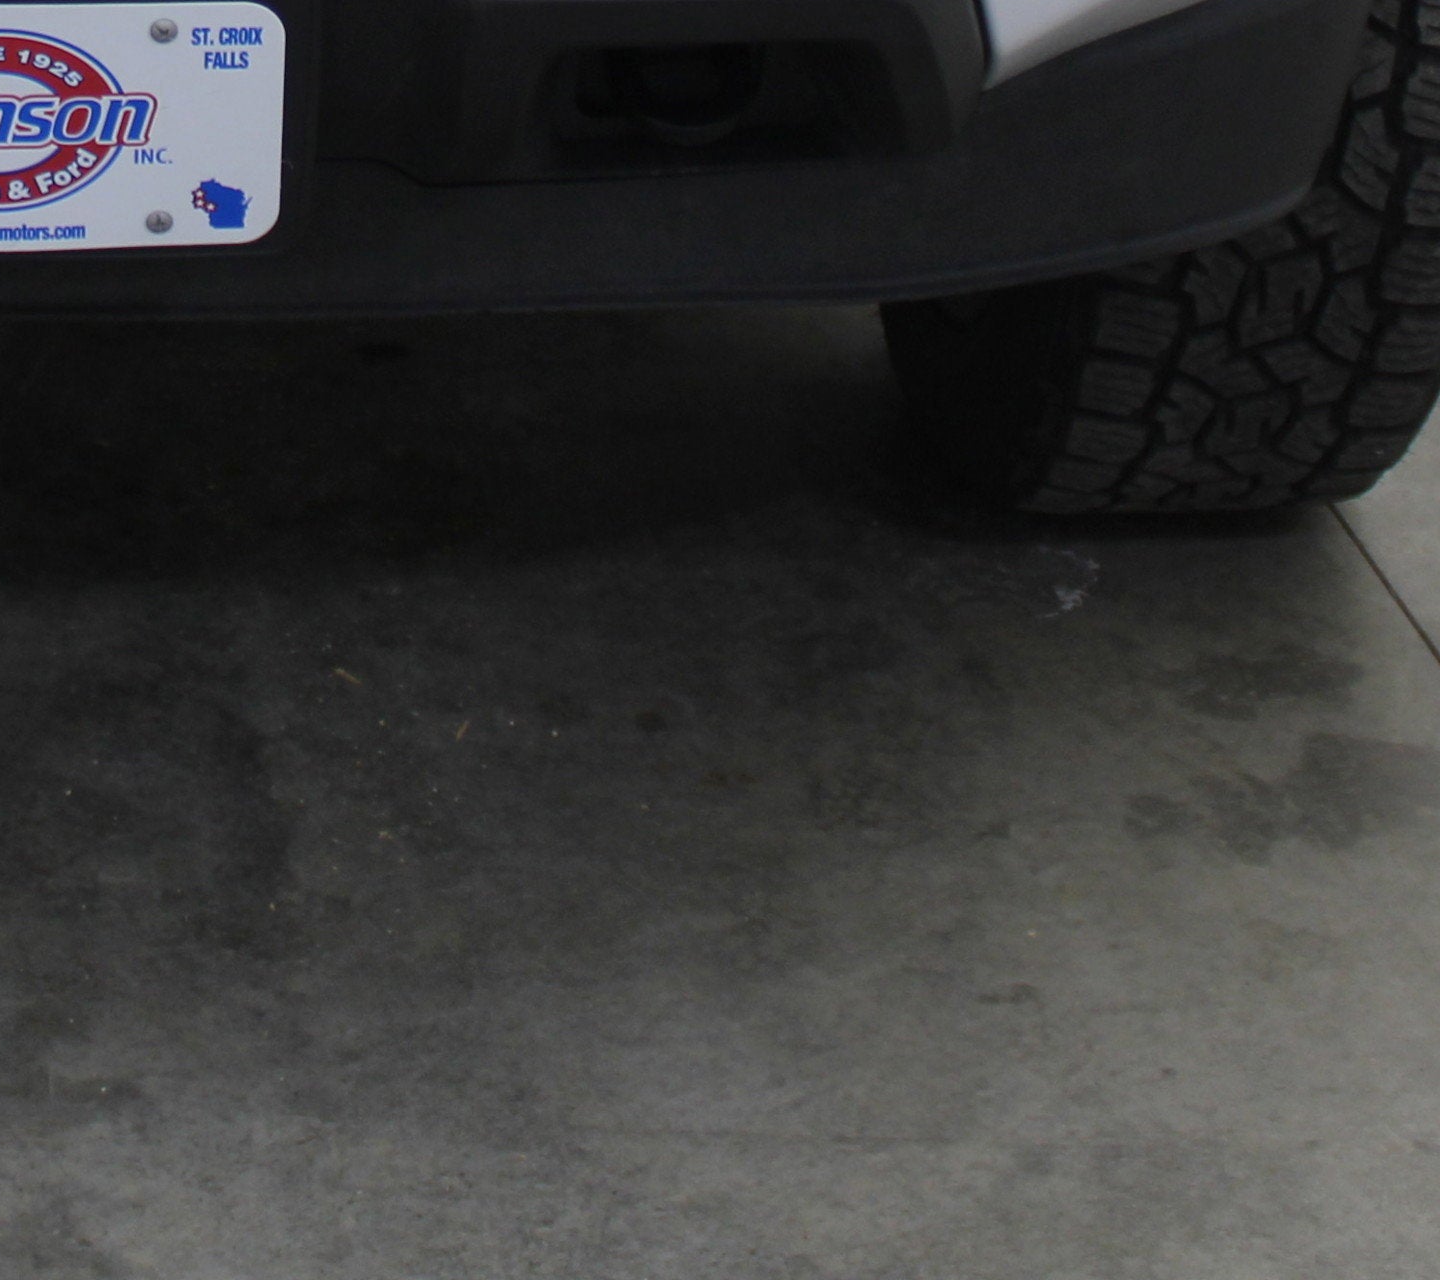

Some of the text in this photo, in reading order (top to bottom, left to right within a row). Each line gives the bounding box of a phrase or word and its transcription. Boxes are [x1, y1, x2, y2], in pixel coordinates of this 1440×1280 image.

[192, 27, 262, 47] ST. CROIX
[18, 49, 83, 89] 1925
[204, 51, 249, 70] FALLS
[134, 148, 174, 166] INC.
[7, 180, 33, 202] &
[35, 147, 100, 195] Ford
